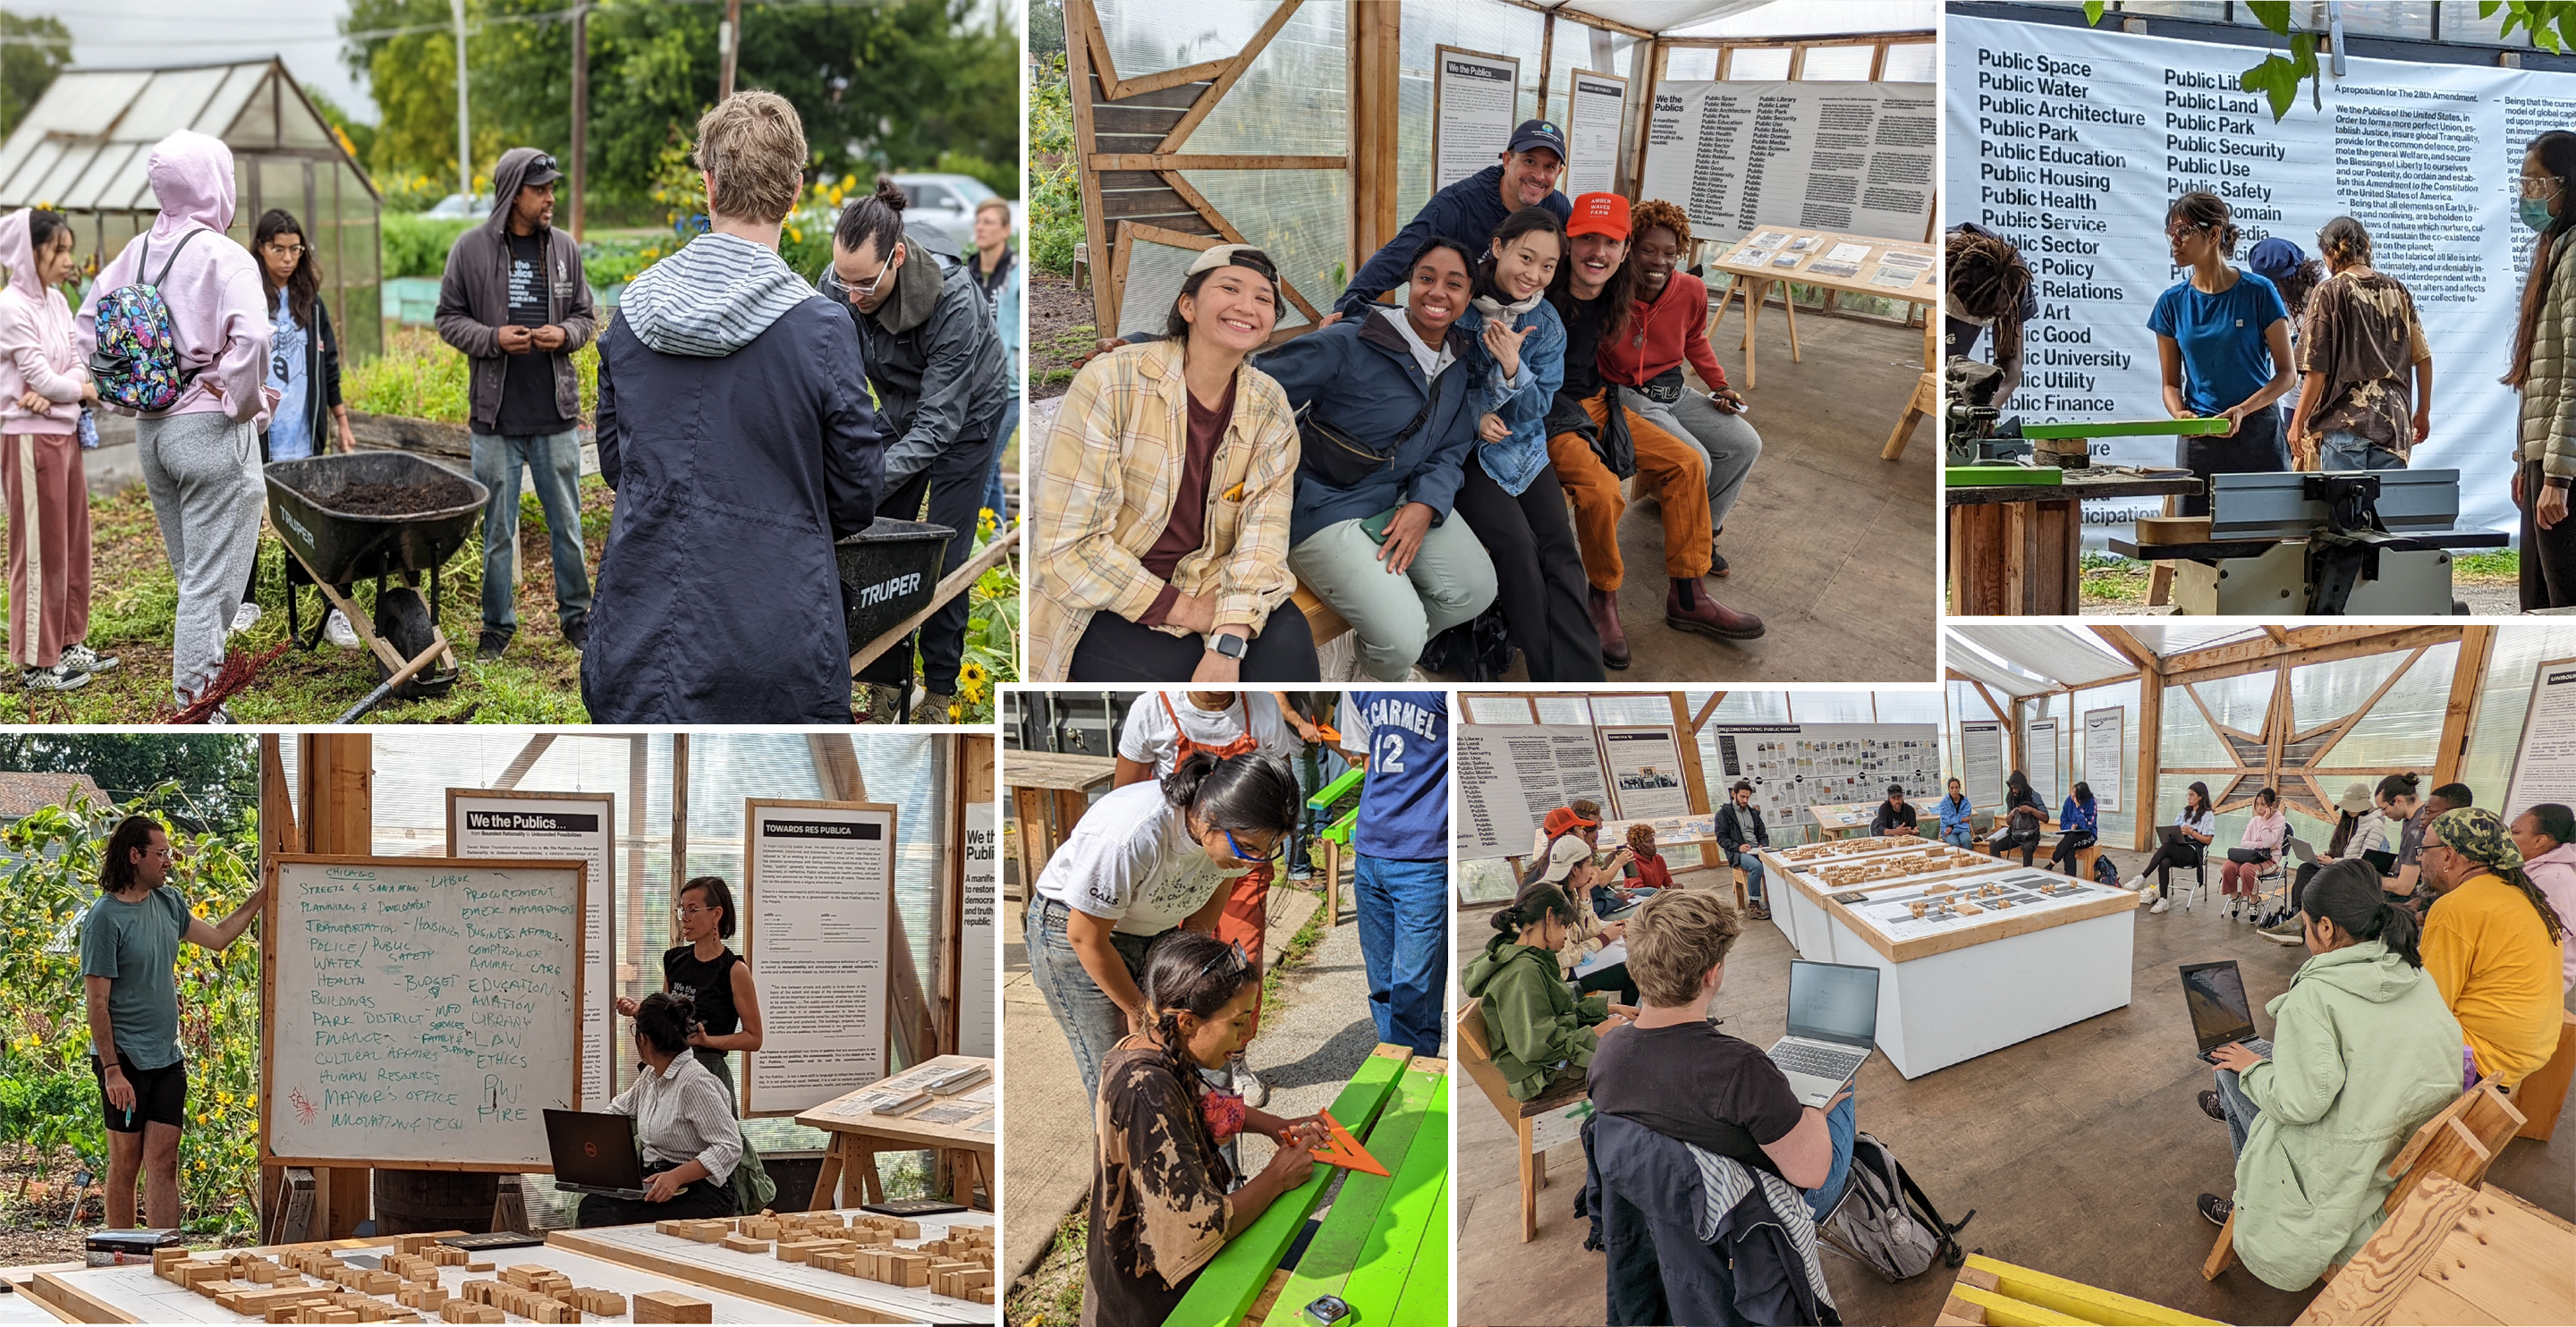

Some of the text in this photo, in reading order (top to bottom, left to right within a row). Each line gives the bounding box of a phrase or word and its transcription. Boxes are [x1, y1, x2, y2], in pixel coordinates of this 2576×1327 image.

[1449, 63, 1458, 73] We
[1459, 64, 1469, 75] the
[1979, 48, 2091, 76] Public Space
[1979, 71, 2088, 98] Public Water
[2165, 69, 2215, 90] Public
[1656, 95, 1682, 103] We the
[2335, 84, 2341, 92] A
[2342, 86, 2385, 97] proposition
[2398, 89, 2413, 98] The
[2433, 92, 2478, 102] Amendment.
[1655, 103, 1684, 112] Publics
[1979, 94, 2145, 126] Public Architecture
[2165, 91, 2258, 114] Public Land
[2335, 105, 2348, 113] We
[2349, 106, 2362, 114] the
[2363, 107, 2390, 116] Publics
[2400, 110, 2412, 118] the
[2413, 111, 2436, 120] United
[2437, 112, 2462, 123] States,
[1980, 117, 2079, 142] Public Park
[2166, 112, 2255, 135] Public Park
[1981, 140, 2126, 168] Public Education
[2166, 134, 2285, 161] Public Security
[2167, 156, 2250, 176] Public Use
[1981, 163, 2110, 192] Public Housing
[1982, 186, 2097, 210] Public Health
[2168, 177, 2271, 203] Public Safety
[1982, 209, 2107, 232] Public Service
[2041, 235, 2099, 254] Sector
[515, 261, 530, 269] the
[2042, 258, 2094, 280] Policy
[2043, 281, 2123, 300] Relations
[2043, 303, 2070, 320] Art
[2044, 326, 2091, 343] Good
[2045, 349, 2131, 370] University
[2045, 371, 2095, 392] Utility
[1652, 386, 1681, 399] FILA
[2045, 394, 2114, 411] Finance
[2080, 506, 2160, 527] ticipation
[279, 504, 315, 549] TRUPER
[861, 573, 920, 608] TRUPER
[1371, 699, 1436, 741] CARMEL
[1374, 734, 1405, 773] 12
[470, 813, 490, 827] We
[491, 815, 511, 828] the
[766, 824, 851, 835] TOWARDS RES PUBLICA
[967, 830, 984, 844] We
[966, 846, 994, 860] Publi
[326, 868, 375, 878] CHICAGO
[431, 874, 470, 888] LABOR
[300, 883, 344, 895] STREETS
[463, 887, 555, 902] PROCUREMENT
[1089, 887, 1119, 905] CALS
[301, 901, 355, 913] PLANNING
[379, 900, 431, 915] DEVELOPMENT
[306, 919, 398, 935] TRANSPORTATION
[964, 917, 991, 927] republic
[466, 923, 515, 939] BUSINESS
[309, 937, 411, 952] POLICE PUBLIC
[314, 957, 363, 969] WATER
[389, 950, 435, 962] SAFETY
[470, 957, 561, 976] ANIMAL CARE
[317, 972, 365, 986] HEALTH
[404, 974, 460, 992] BUDGET
[469, 977, 553, 996] EDUCATION
[674, 982, 696, 994] We the
[436, 1004, 461, 1017] INFO
[472, 995, 536, 1013] AVIATION
[313, 1012, 424, 1026] PARK DISTRICT
[315, 1031, 382, 1046] FINANCE
[474, 1031, 521, 1048] LAW
[315, 1052, 381, 1065] CULTURAL
[477, 1054, 527, 1069] ETHICS
[320, 1068, 440, 1085] HUMAN RESOURCES
[406, 1091, 458, 1105] OFFICE
[477, 1105, 528, 1123] FIRE
[428, 1117, 462, 1131] TECH
